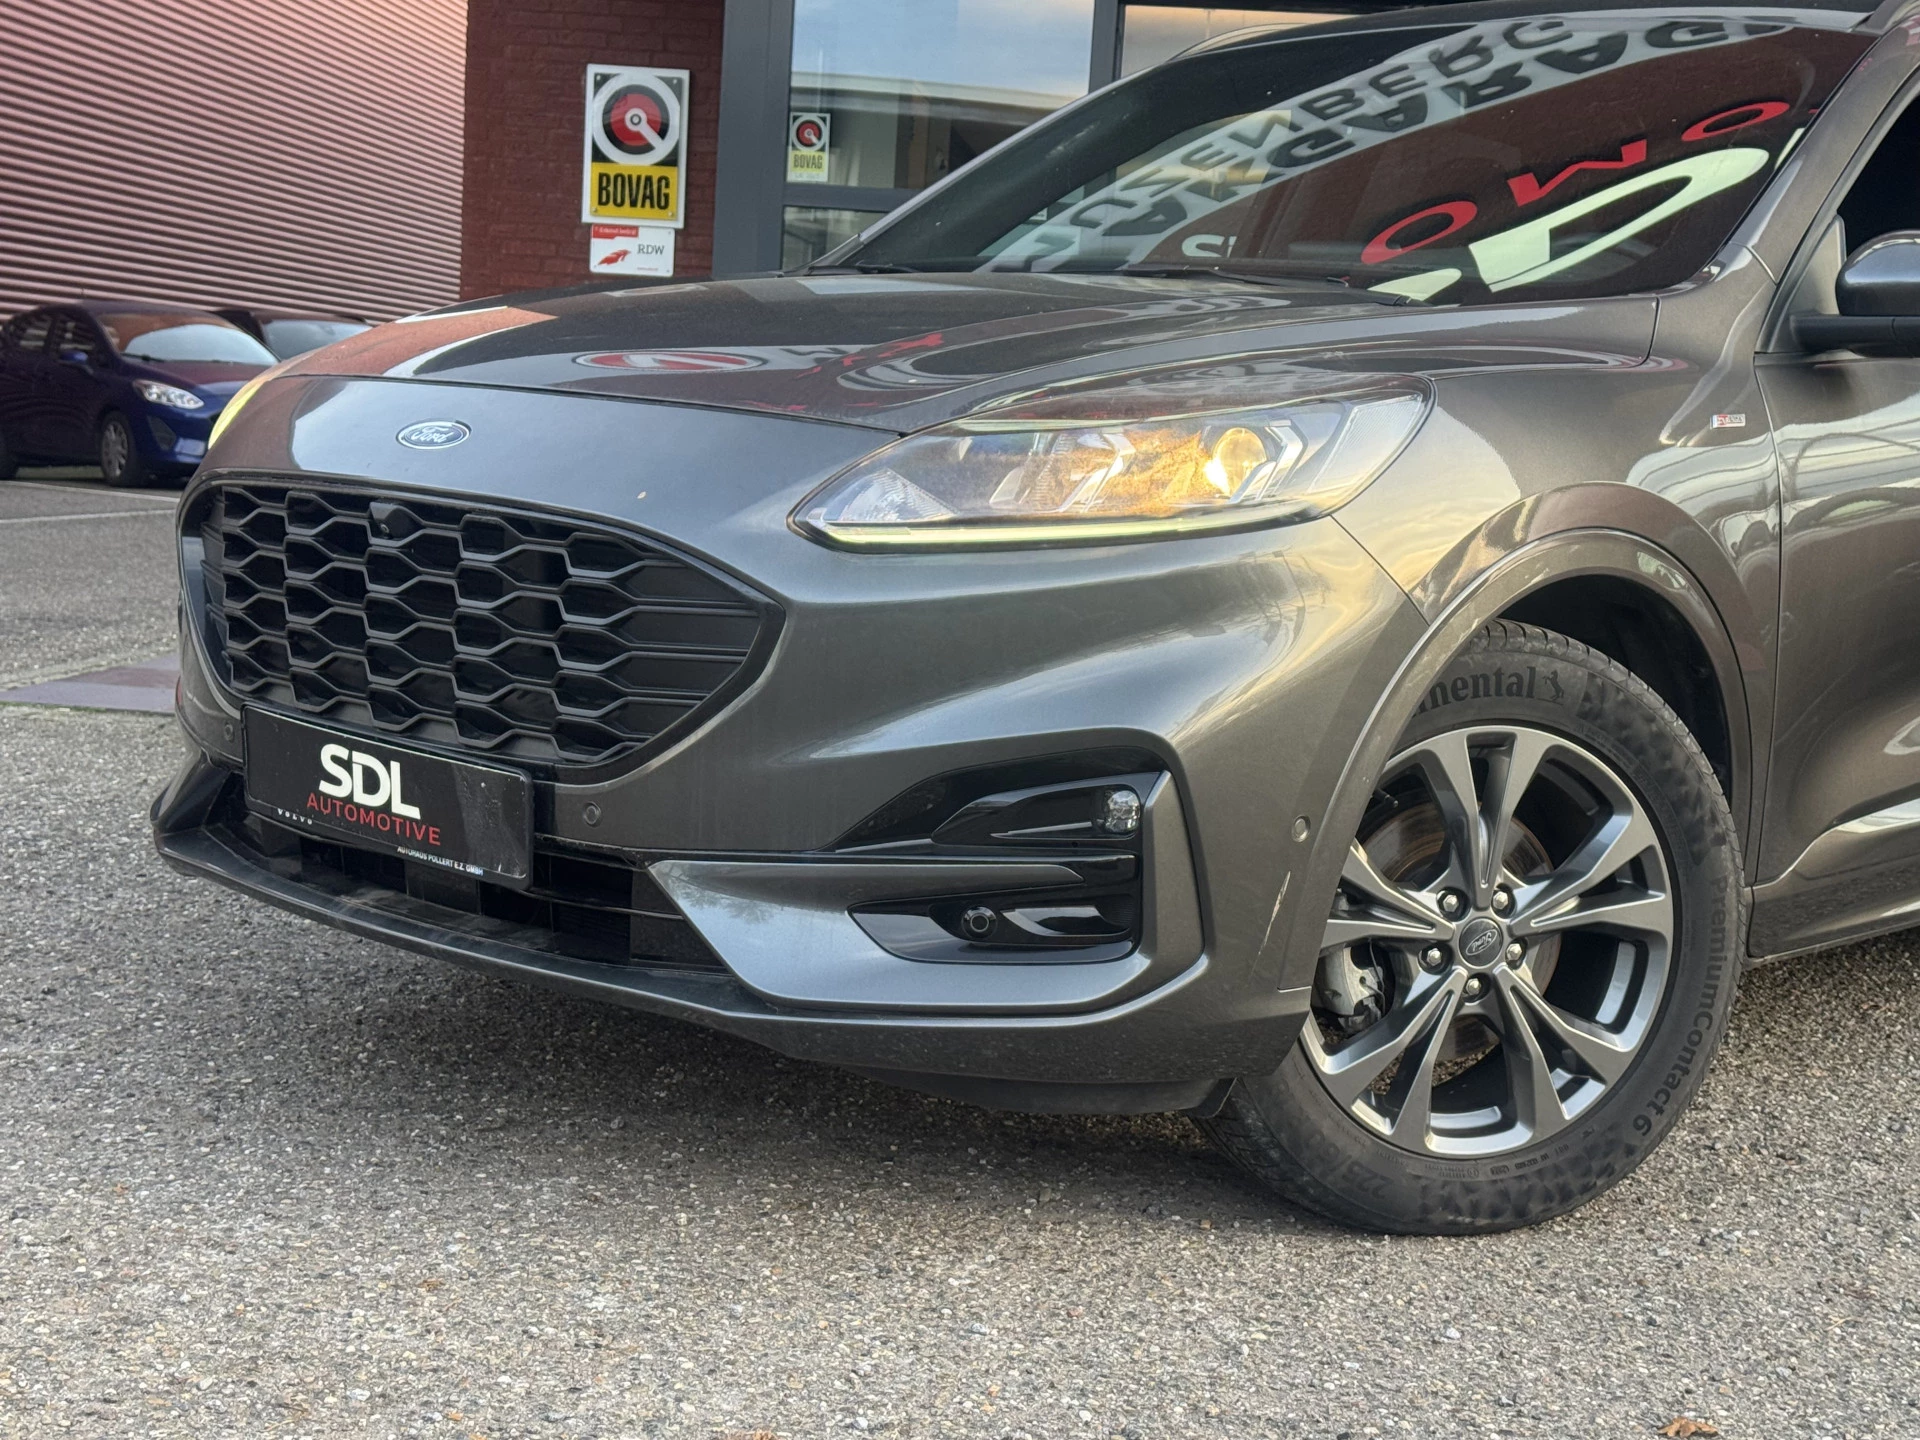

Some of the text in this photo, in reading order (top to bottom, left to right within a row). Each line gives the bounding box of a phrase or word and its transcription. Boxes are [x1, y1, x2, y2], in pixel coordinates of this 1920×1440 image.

[793, 153, 823, 169] BOVAG
[597, 172, 670, 210] BOVAG
[637, 243, 665, 255] RDW
[319, 743, 421, 820] SDL
[306, 792, 441, 846] AUTOMOTIVE
[1632, 875, 1729, 1137] PremiumContact 6
